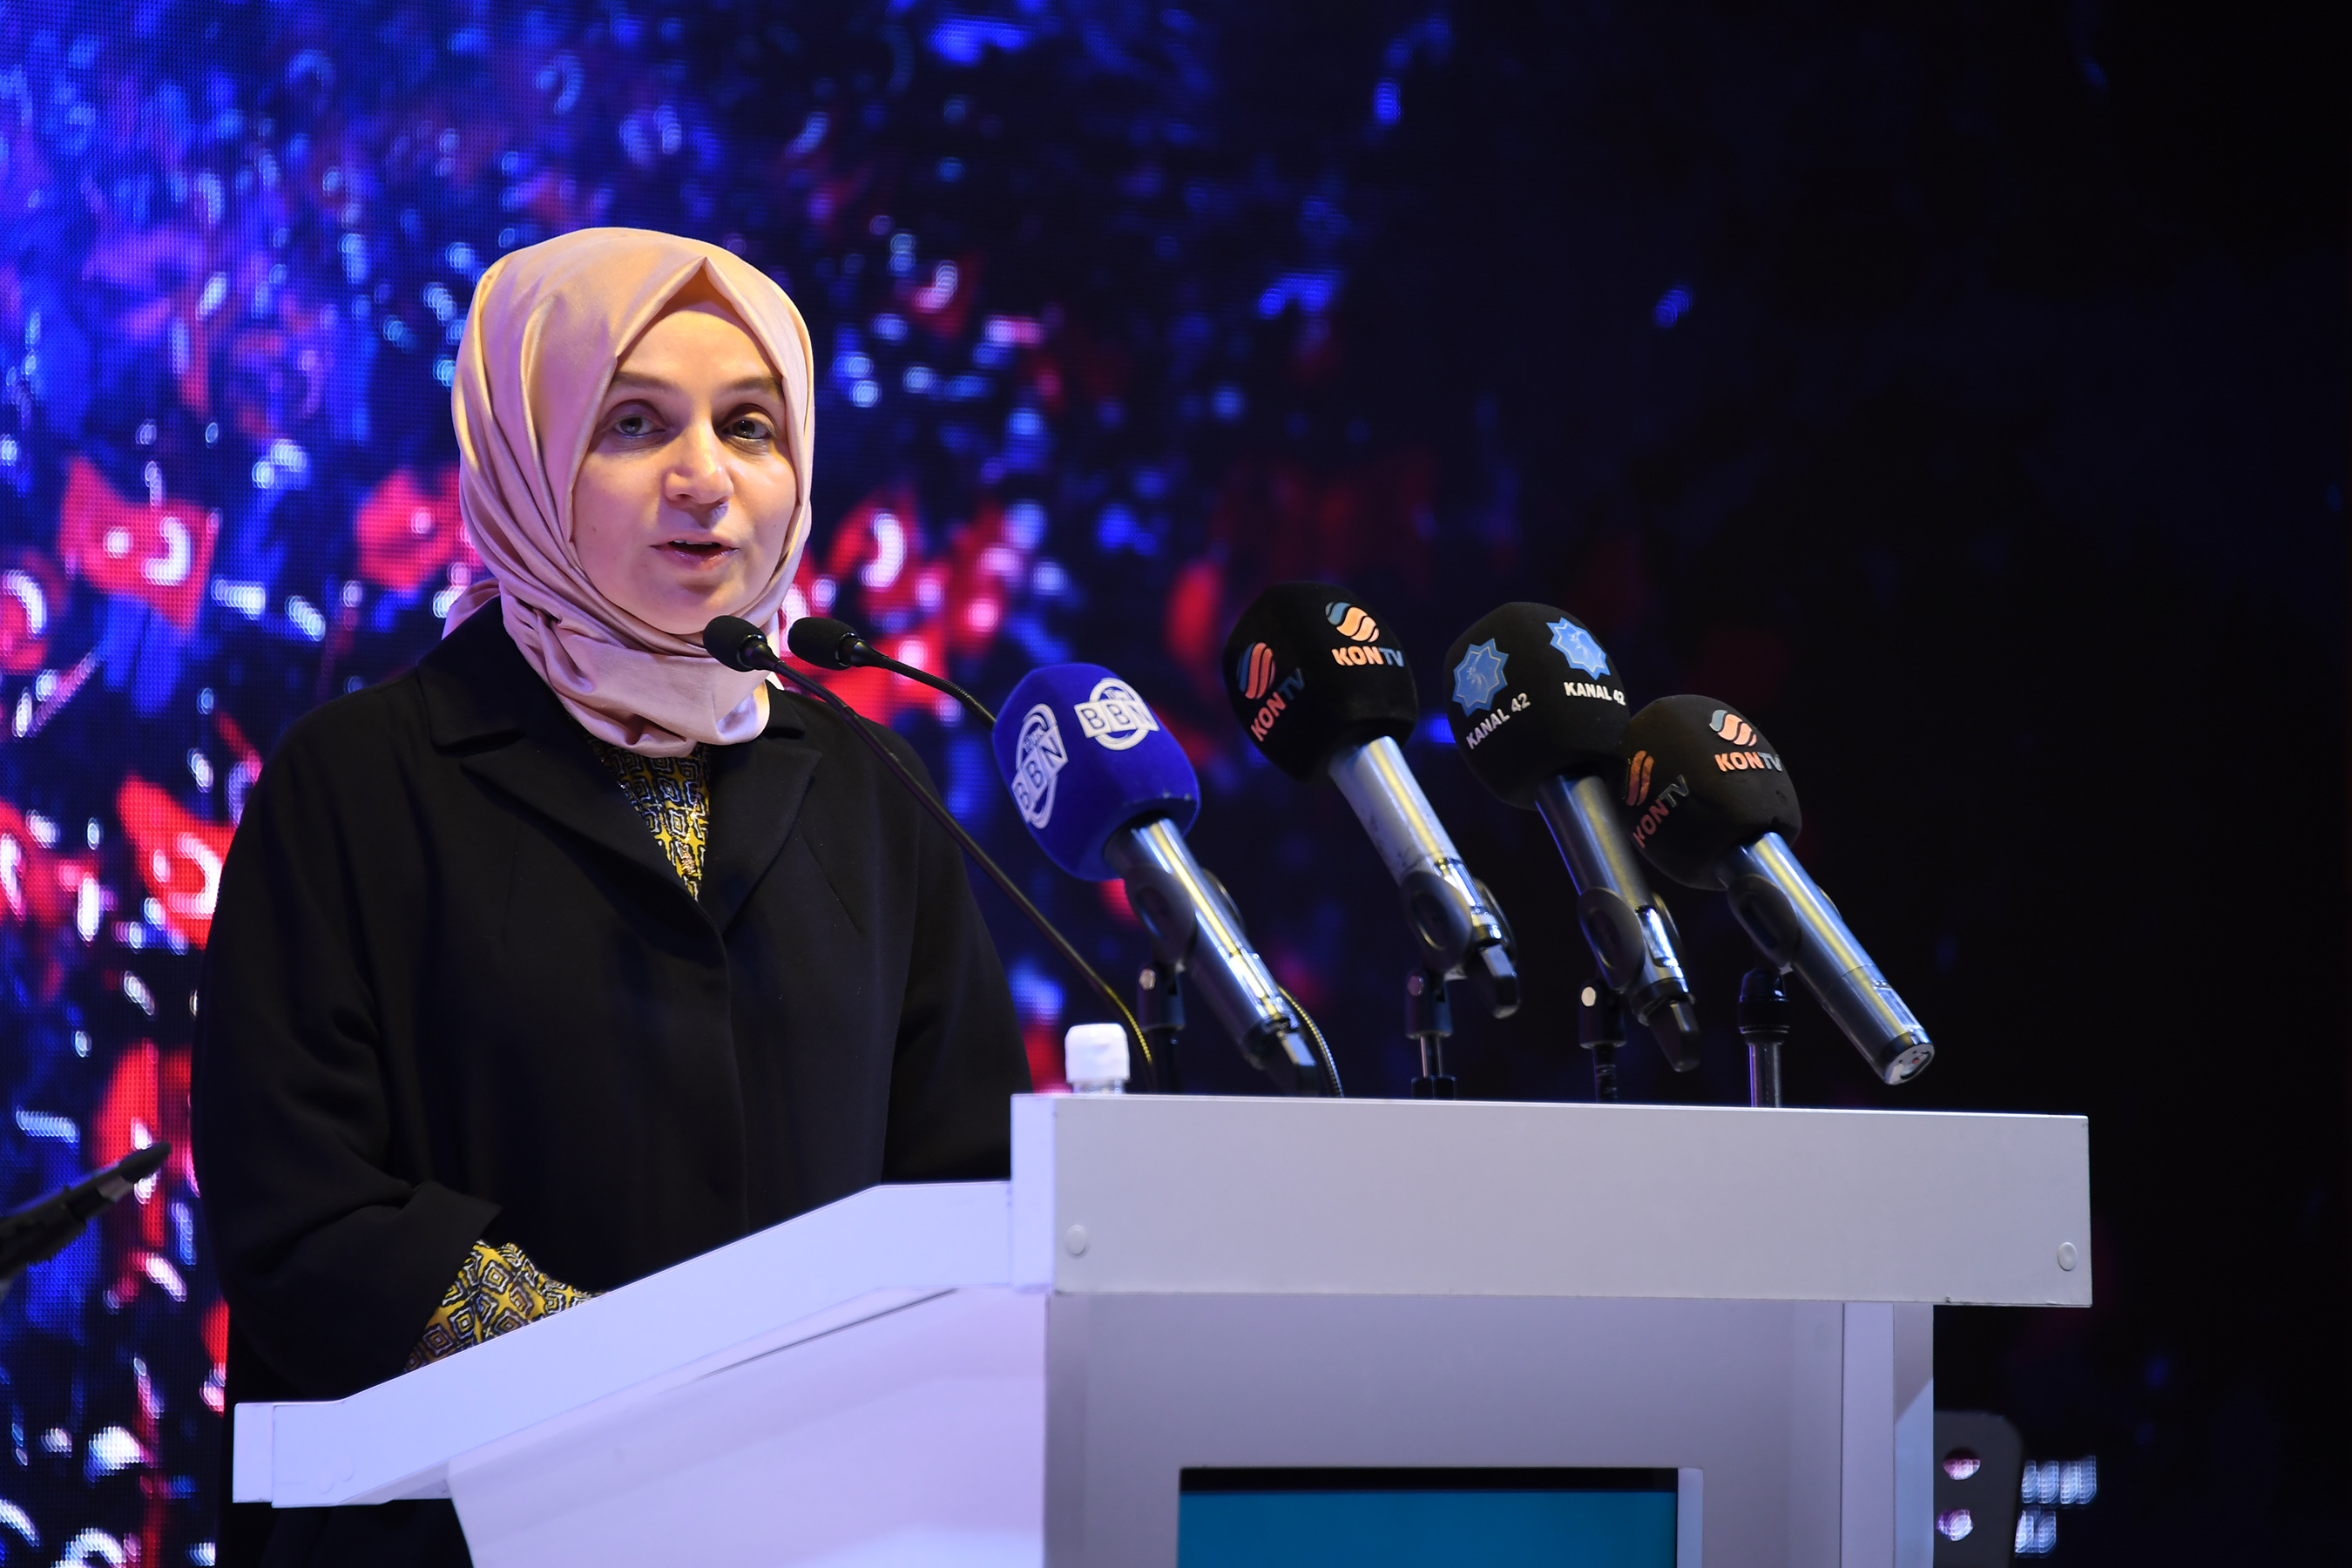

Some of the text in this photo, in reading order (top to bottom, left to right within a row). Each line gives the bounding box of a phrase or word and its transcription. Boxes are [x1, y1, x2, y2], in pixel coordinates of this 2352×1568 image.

[1331, 645, 1405, 667] KONTV
[1563, 681, 1626, 706] KANAL 42
[1078, 701, 1157, 732] BBN
[1465, 693, 1531, 750] KANAL 42
[1013, 732, 1065, 814] BBN
[1713, 751, 1783, 772] KONTV
